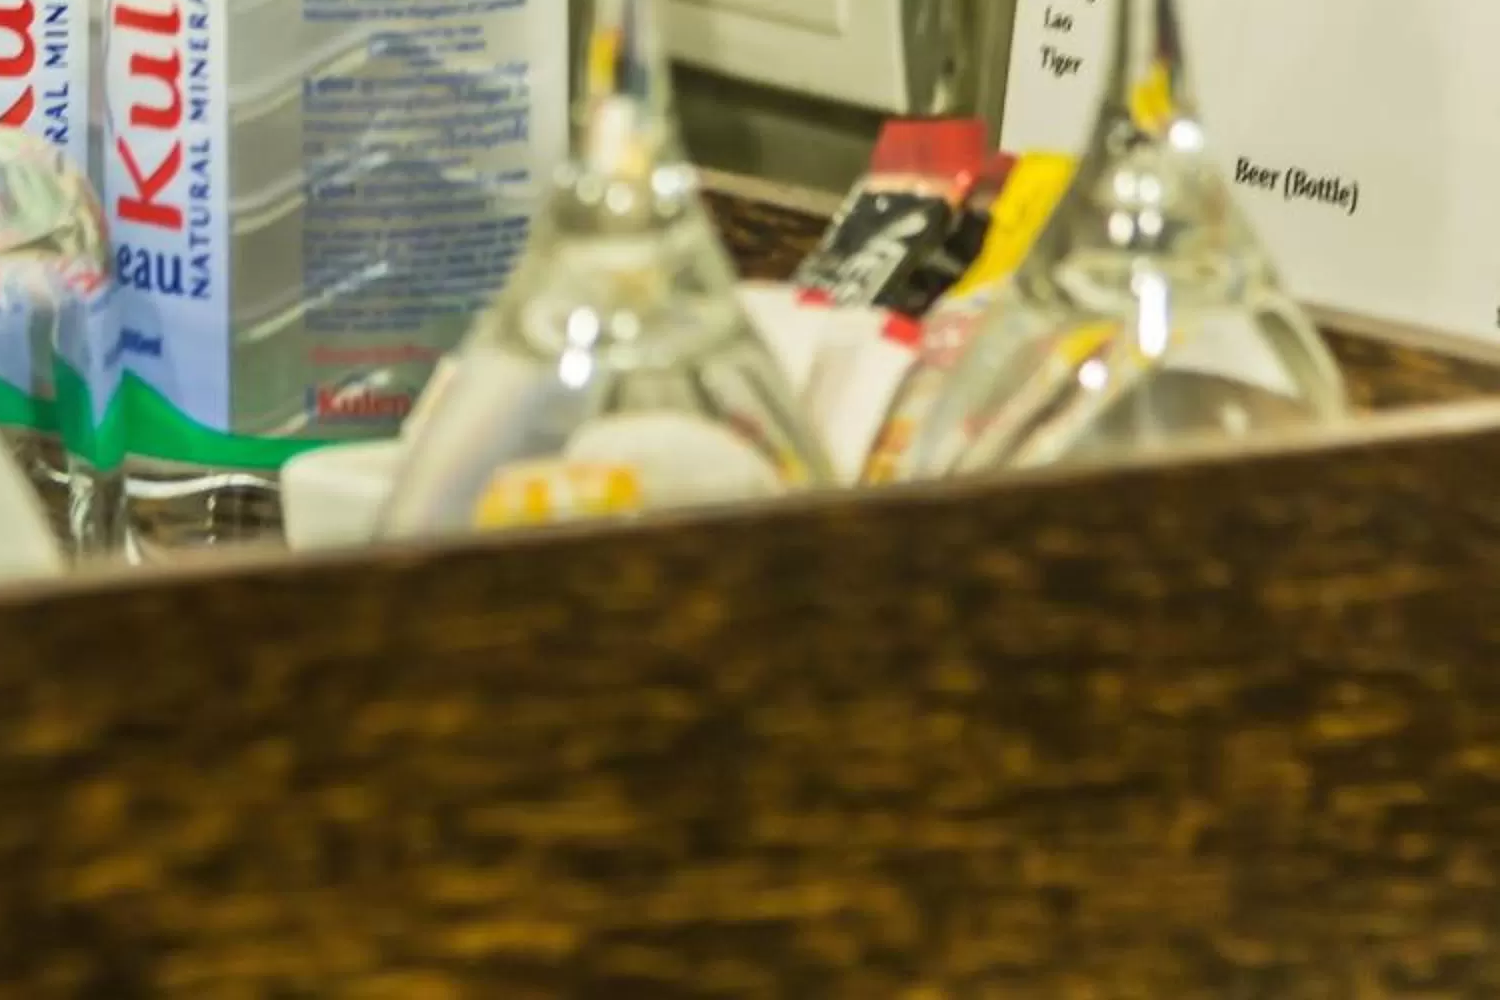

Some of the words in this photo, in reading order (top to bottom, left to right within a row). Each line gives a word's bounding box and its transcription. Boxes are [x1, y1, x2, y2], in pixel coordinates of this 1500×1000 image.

[1043, 5, 1073, 32] Lao
[1039, 43, 1083, 77] Tiger
[1234, 156, 1279, 190] Beer
[1283, 165, 1359, 215] (Bottle)
[187, 137, 212, 298] NATURAL
